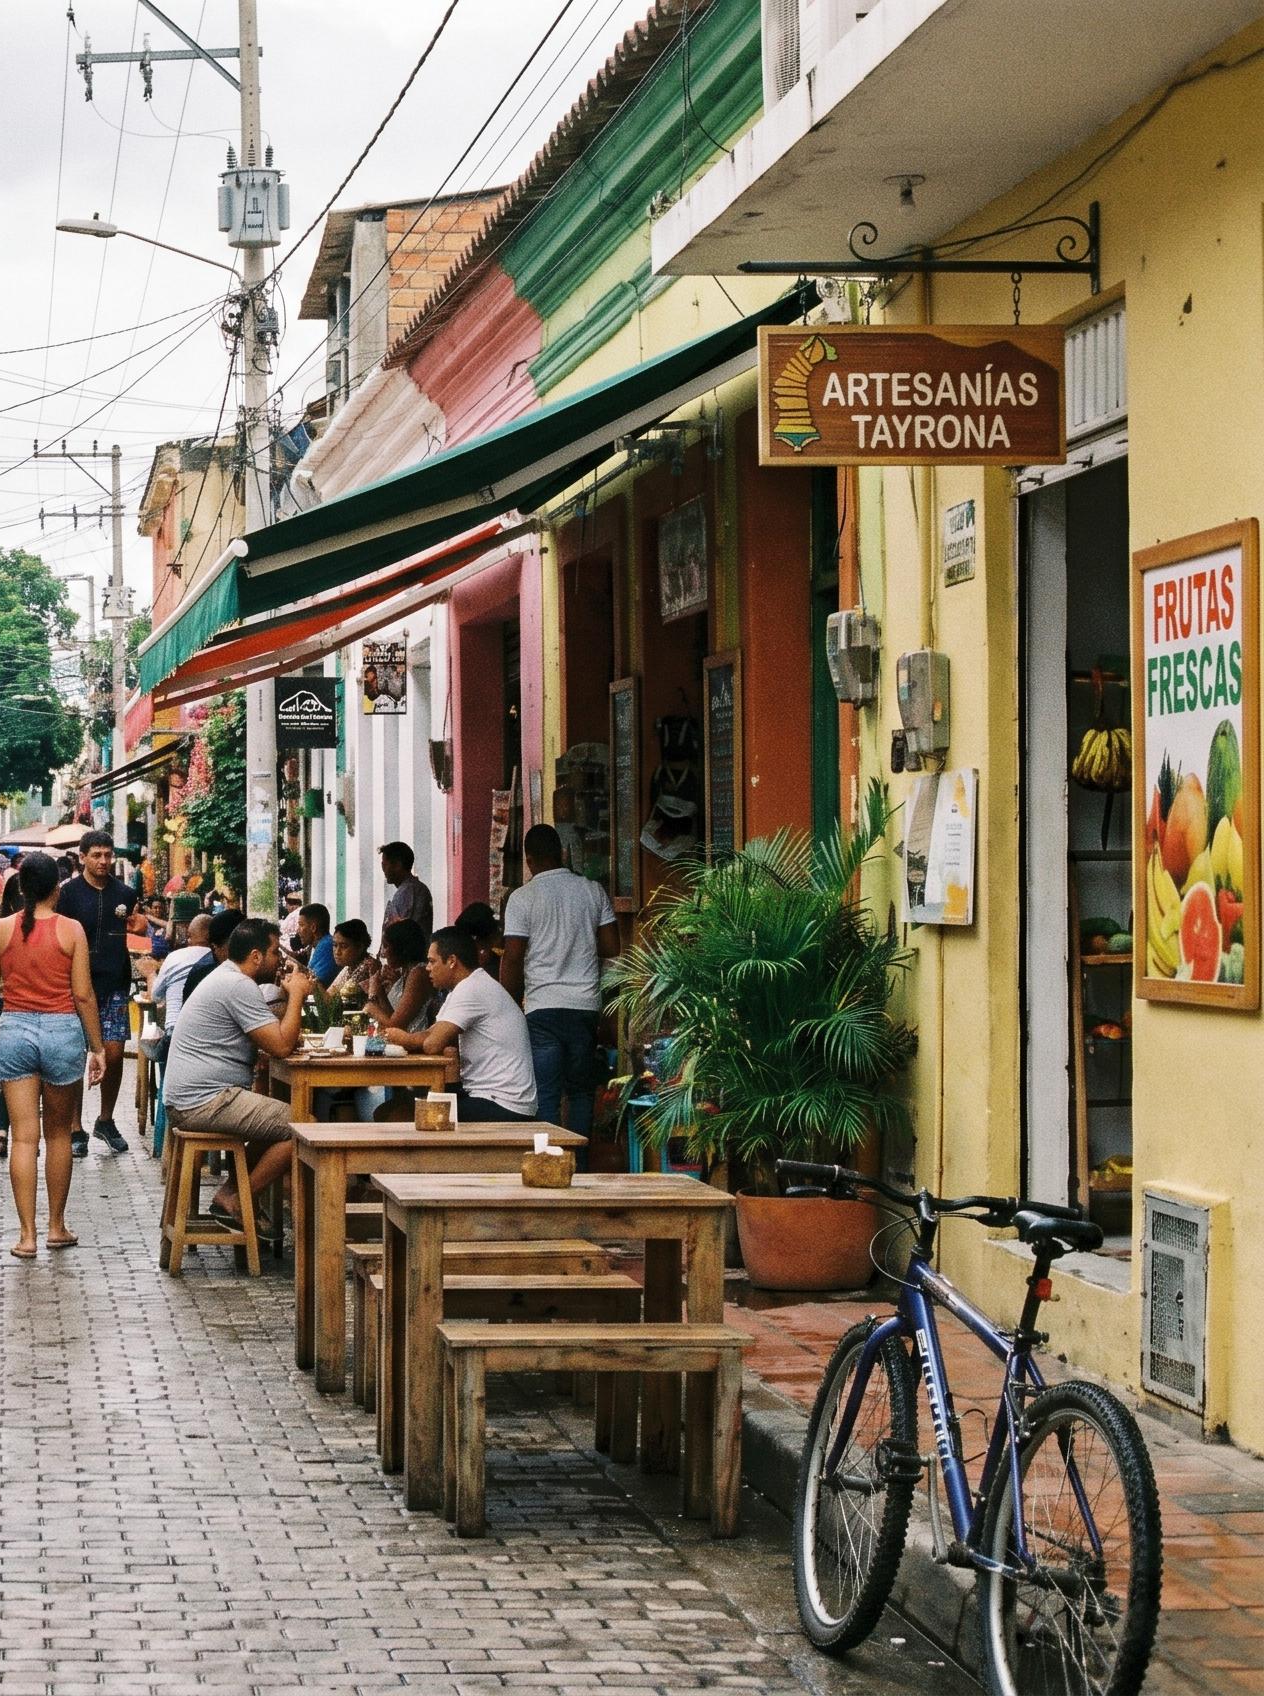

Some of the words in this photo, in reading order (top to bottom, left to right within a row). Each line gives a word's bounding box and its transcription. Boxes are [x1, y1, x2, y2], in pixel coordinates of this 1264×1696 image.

[822, 363, 1039, 406] ARTESANÍAS
[851, 414, 1011, 449] TAYRONA
[1154, 564, 1234, 644] FRUTAS
[1147, 640, 1242, 717] FRESCAS
